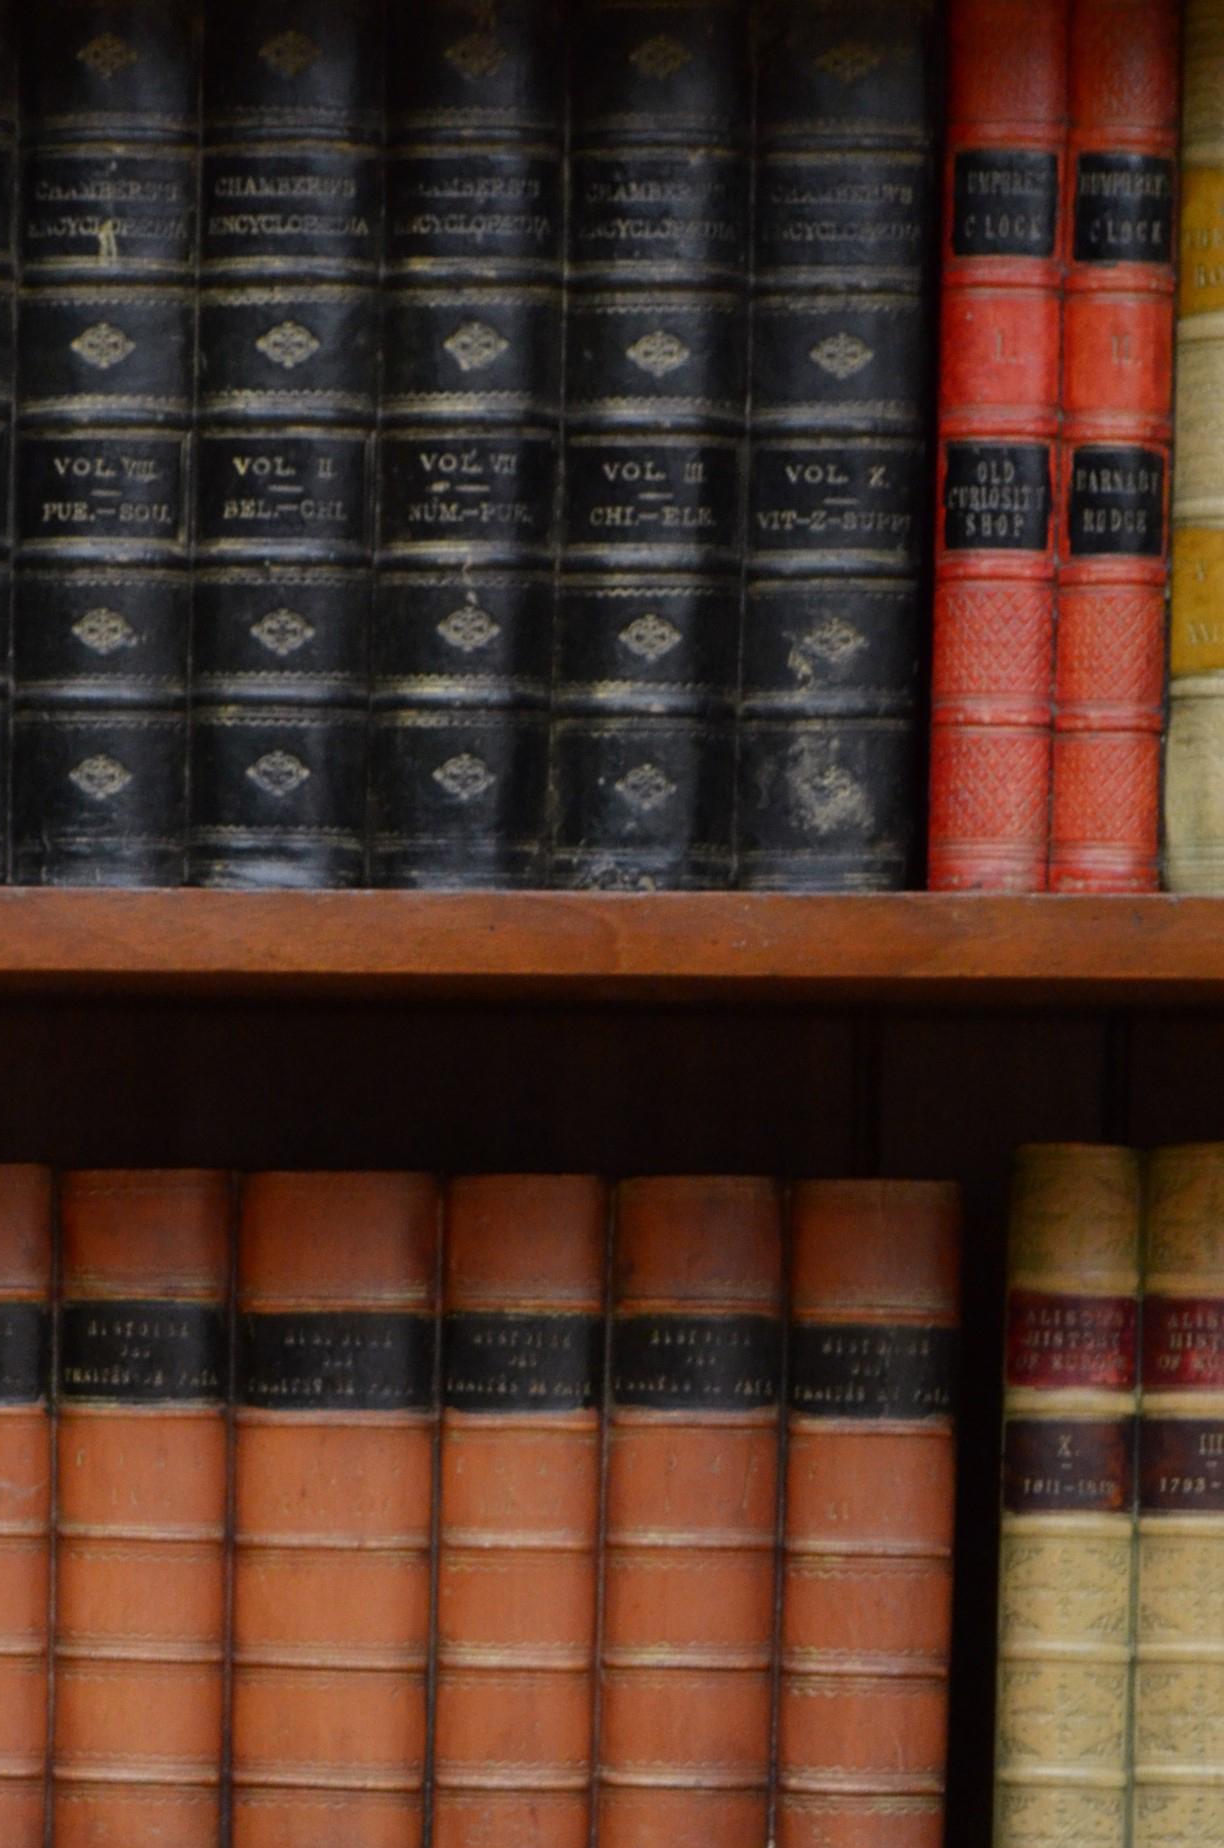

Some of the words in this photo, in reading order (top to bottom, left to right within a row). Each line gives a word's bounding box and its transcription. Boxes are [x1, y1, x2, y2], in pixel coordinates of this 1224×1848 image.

[53, 457, 117, 478] VOL.
[232, 457, 296, 477] VOL.
[419, 450, 483, 475] VOL.
[602, 462, 667, 482] VOL.
[976, 459, 1016, 485] OLD
[784, 465, 849, 485] VOL.
[963, 512, 1025, 538] SHOP
